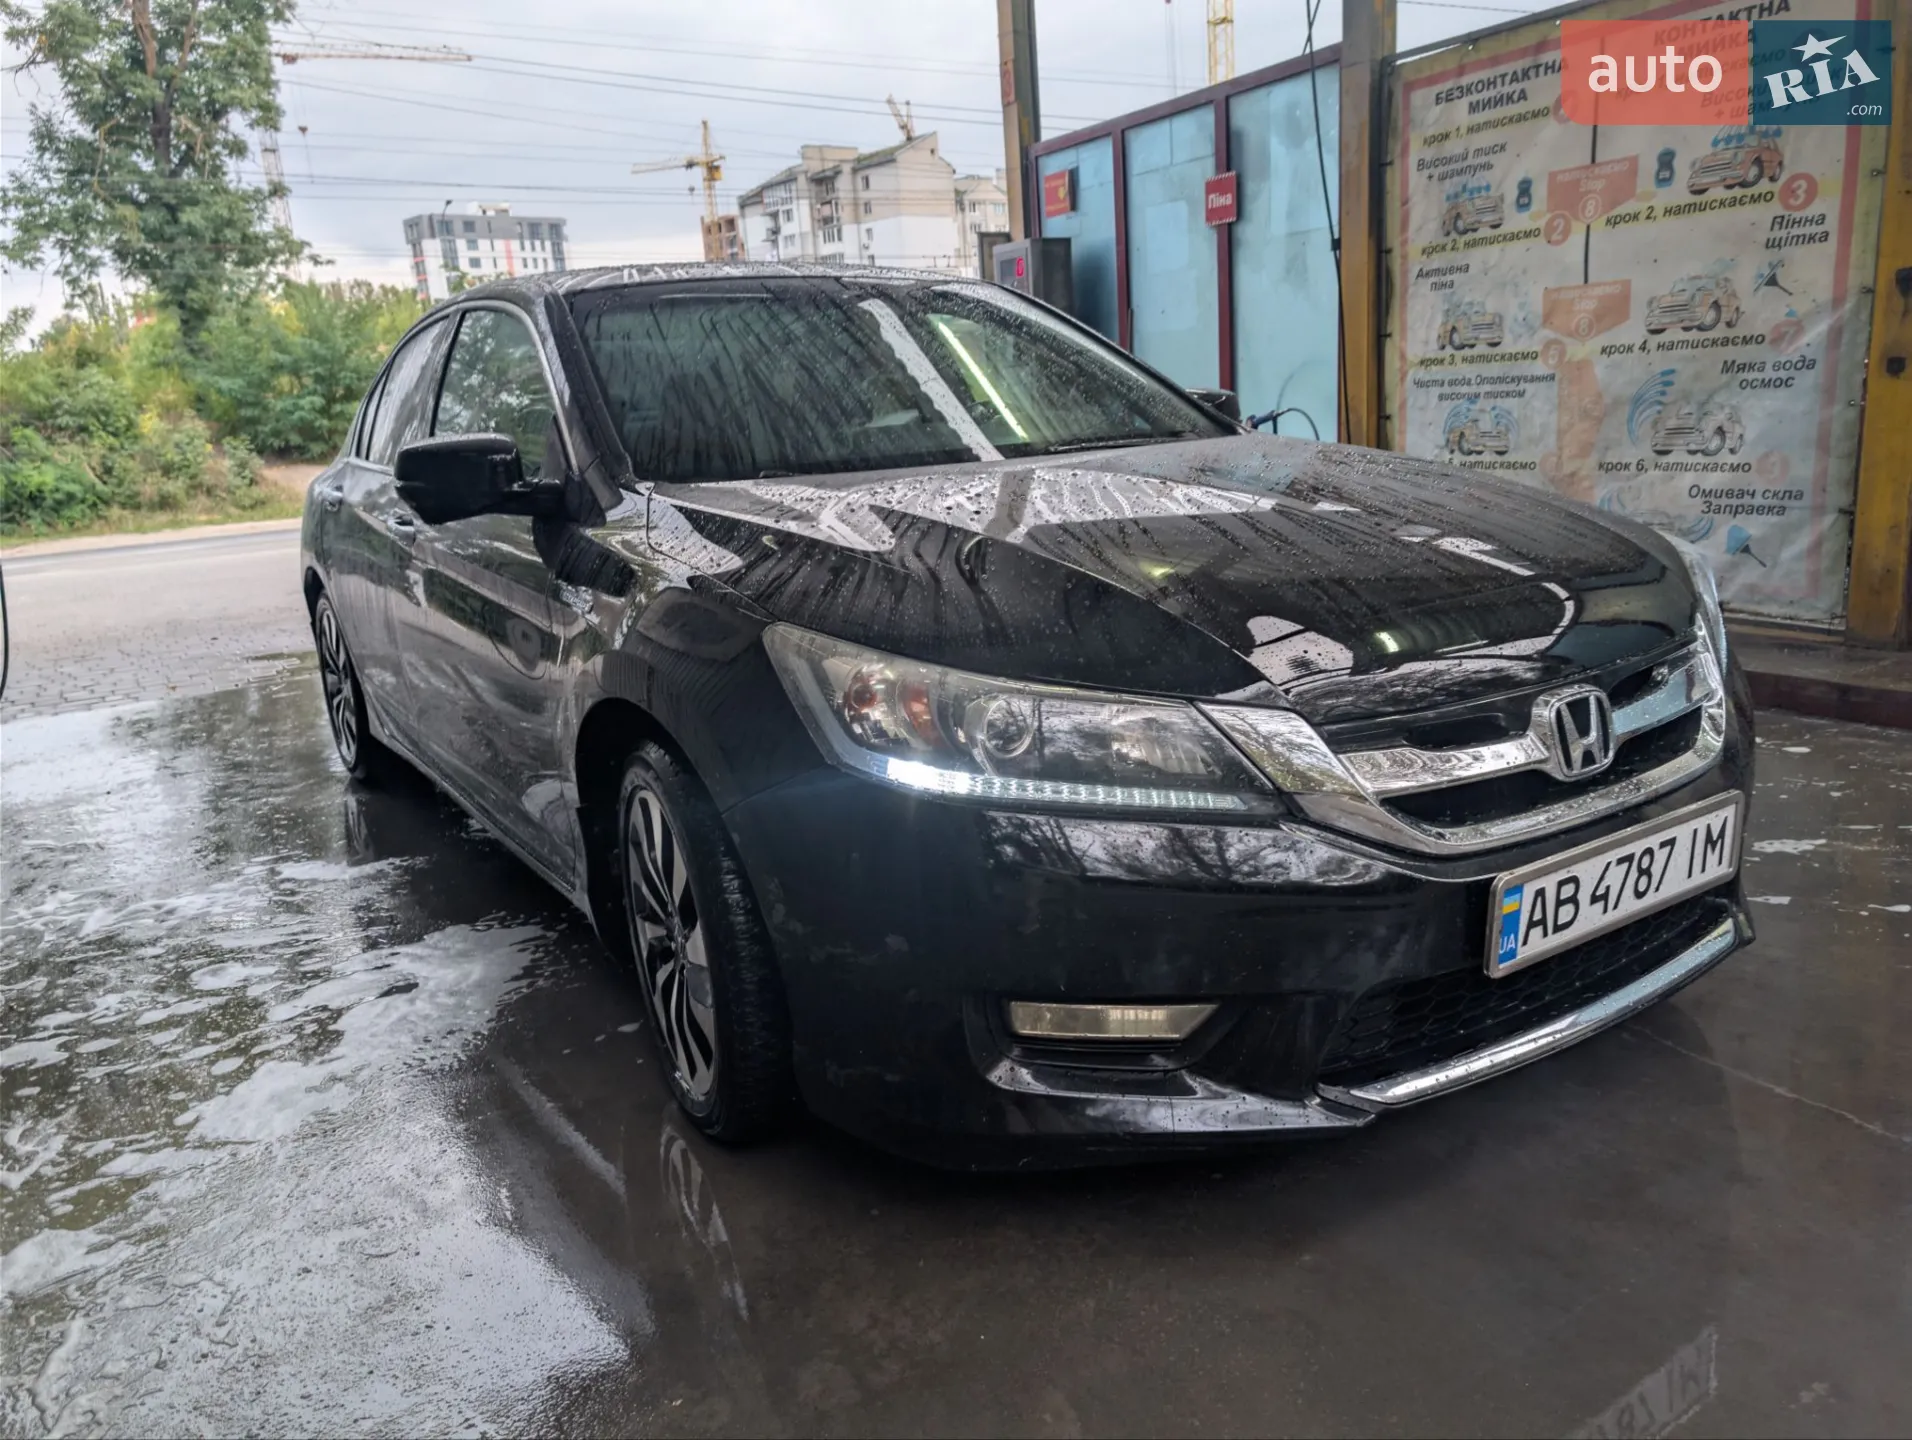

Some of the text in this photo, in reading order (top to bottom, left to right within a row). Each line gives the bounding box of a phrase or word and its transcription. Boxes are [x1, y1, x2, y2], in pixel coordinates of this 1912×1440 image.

[1435, 57, 1569, 106] БЕЗКОНТАКТНА
[1468, 87, 1528, 115] МИЙКА
[1423, 130, 1452, 147] крок
[1466, 106, 1550, 136] натискаємо
[1416, 141, 1508, 172] Високий тиск
[1438, 161, 1494, 182] шампунь
[1209, 193, 1232, 209] Піна
[1585, 200, 1595, 217] 8
[1604, 179, 1808, 230] крок 2, натискаємо 3
[1770, 212, 1826, 232] Пінна
[1421, 242, 1447, 258] крок
[1463, 227, 1541, 250] натискаємо
[1551, 218, 1564, 240] 2
[1765, 230, 1830, 251] щітка
[1415, 263, 1470, 280] Активна
[1430, 278, 1455, 292] піна
[1600, 343, 1634, 357] крок
[1638, 338, 1651, 354] 4,
[1656, 333, 1765, 352] натискаємо
[1419, 358, 1445, 368] крок
[1461, 350, 1539, 365] натискаємо
[1721, 355, 1817, 375] Мяка вода
[1413, 377, 1445, 389] Чиста
[1739, 375, 1795, 391] осмос
[1483, 388, 1526, 399] тиском
[1460, 460, 1537, 471] натискаємо
[1597, 460, 1632, 475] крок
[1635, 458, 1649, 474] 6,
[1654, 460, 1752, 474] натискаємо
[1688, 484, 1804, 501] Омивач скла
[1701, 500, 1787, 518] Заправка
[1499, 815, 1728, 954] UA AB 4787 IM
